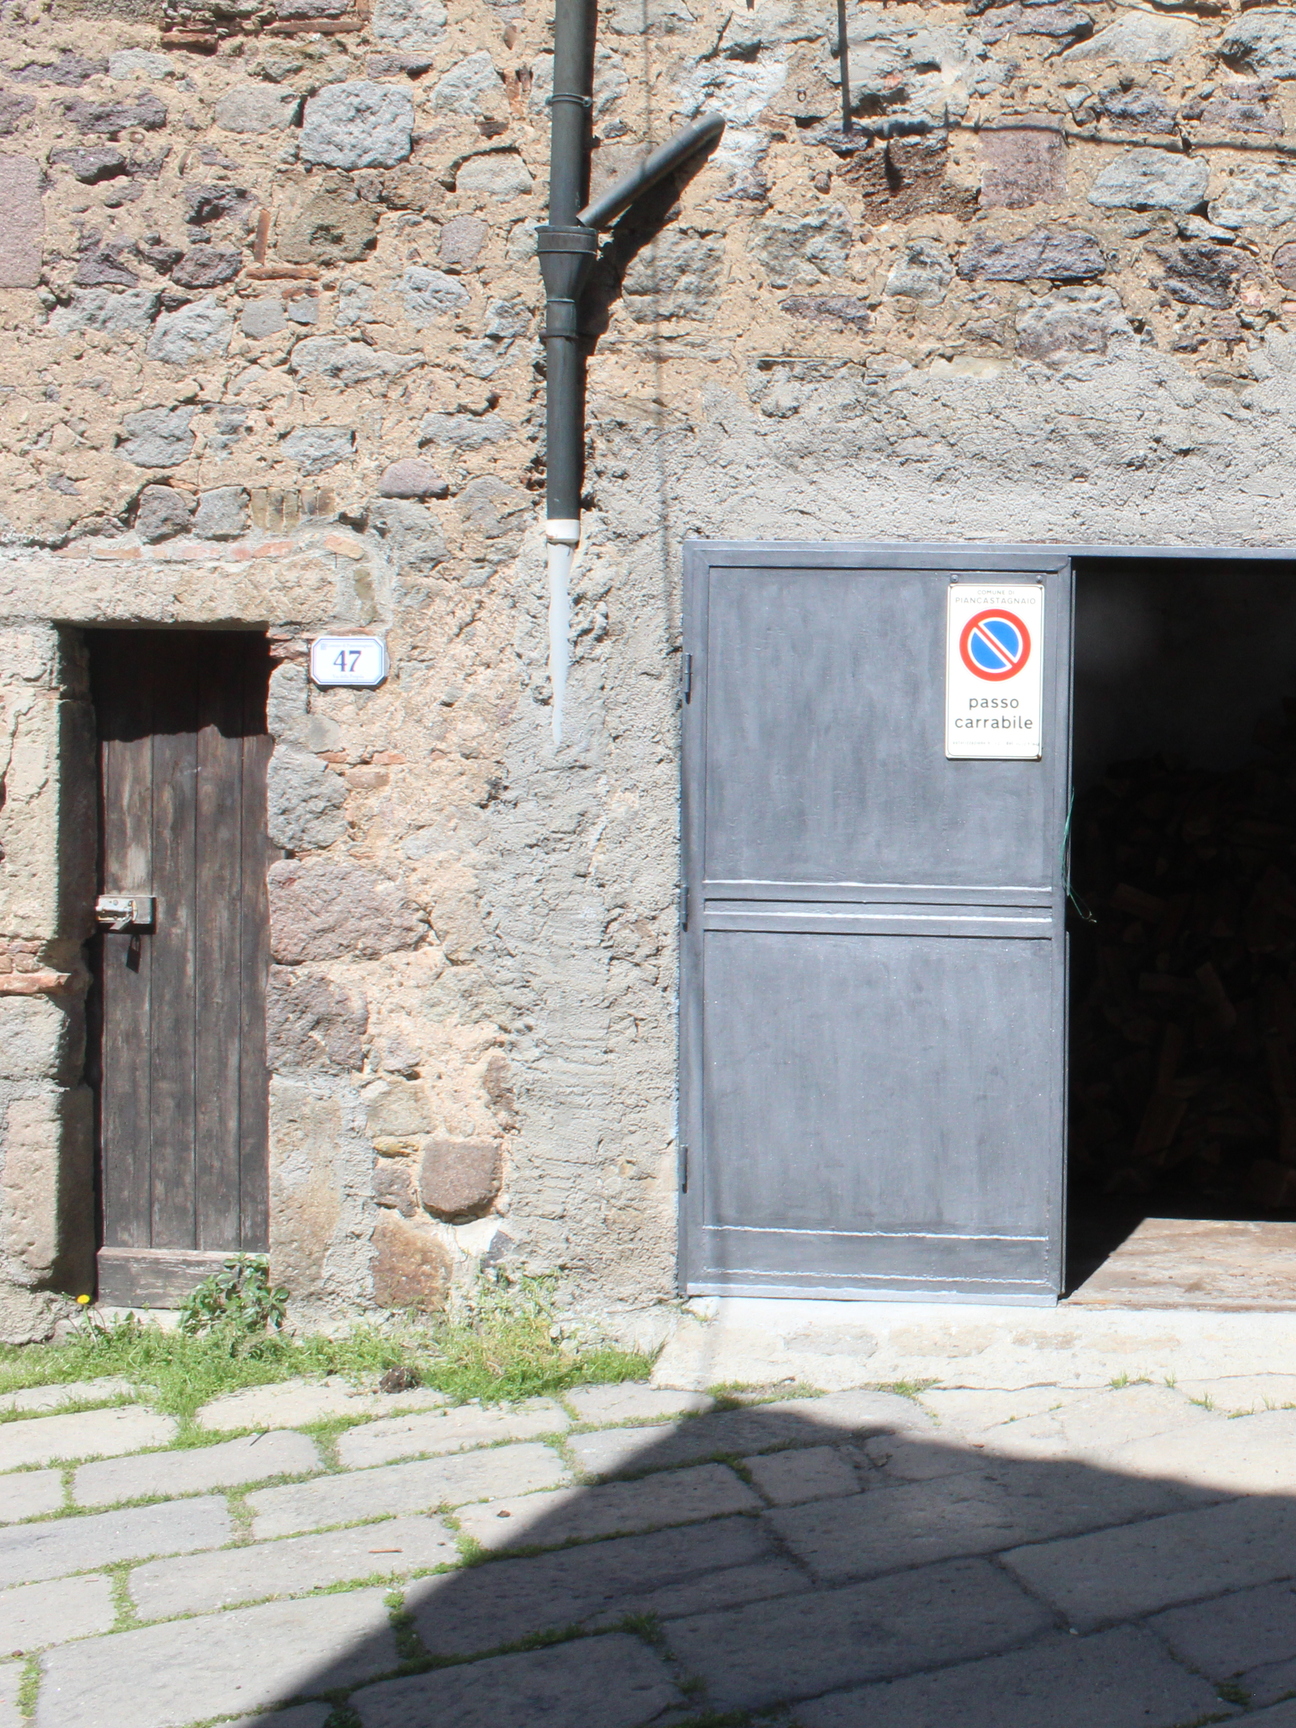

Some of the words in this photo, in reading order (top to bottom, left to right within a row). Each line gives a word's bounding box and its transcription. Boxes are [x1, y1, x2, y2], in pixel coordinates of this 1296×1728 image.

[955, 596, 1036, 605] PIANCASTAGNAIO
[333, 649, 362, 673] 47
[968, 697, 1020, 711] passo
[954, 714, 1034, 730] carrabile
